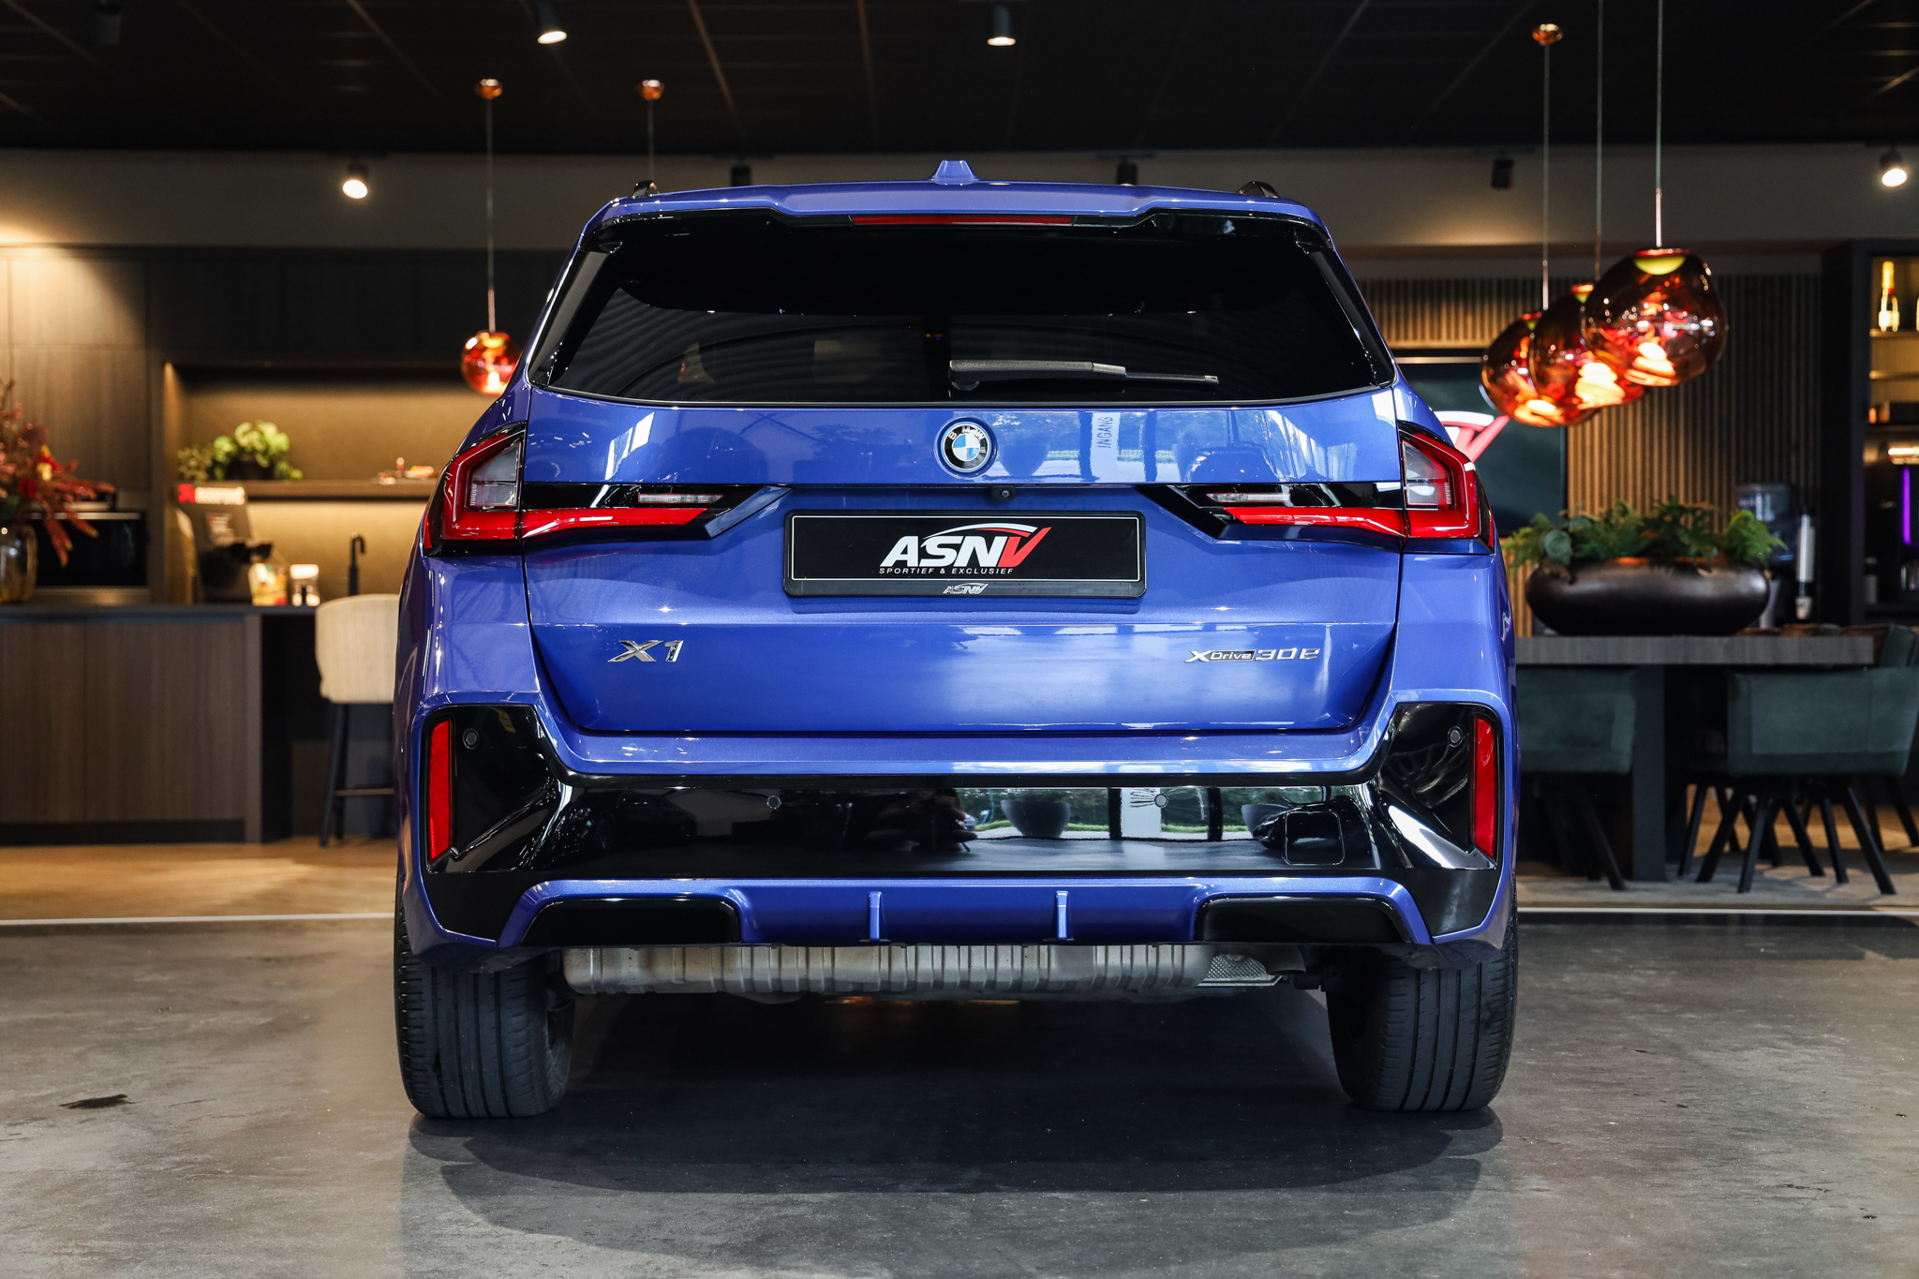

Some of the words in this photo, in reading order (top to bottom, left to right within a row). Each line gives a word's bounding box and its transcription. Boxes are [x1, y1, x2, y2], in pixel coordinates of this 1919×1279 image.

[948, 425, 986, 440] BMW
[878, 567, 935, 575] SPORTIEF
[939, 567, 946, 575] &
[951, 567, 1014, 575] EXCLUSIEF
[607, 640, 685, 662] X1
